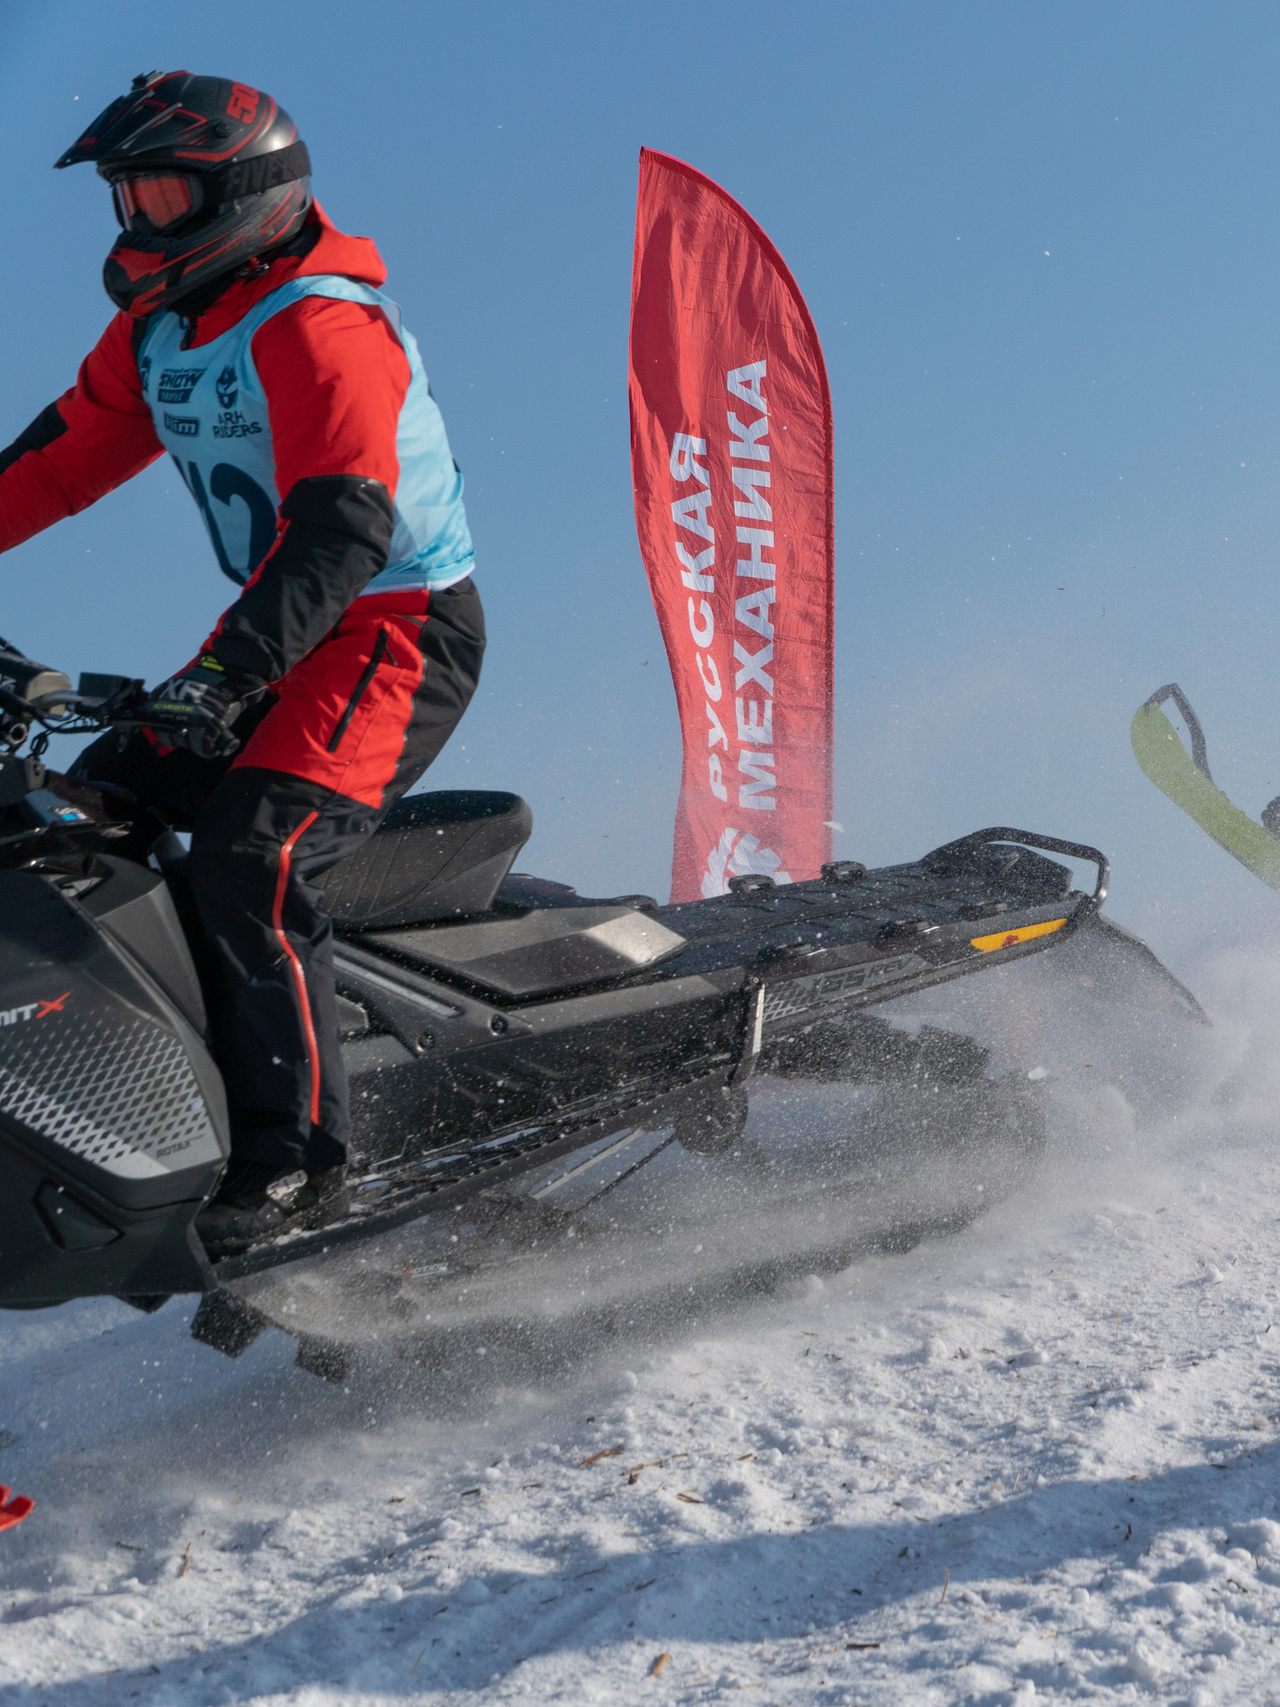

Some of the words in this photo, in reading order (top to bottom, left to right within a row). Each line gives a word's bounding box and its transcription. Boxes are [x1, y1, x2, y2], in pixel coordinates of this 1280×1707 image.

[212, 421, 262, 439] RIDERS
[670, 431, 728, 802] РУССКАЯ
[726, 359, 777, 811] МЕХАНИКА
[156, 1140, 192, 1159] ROTAX
